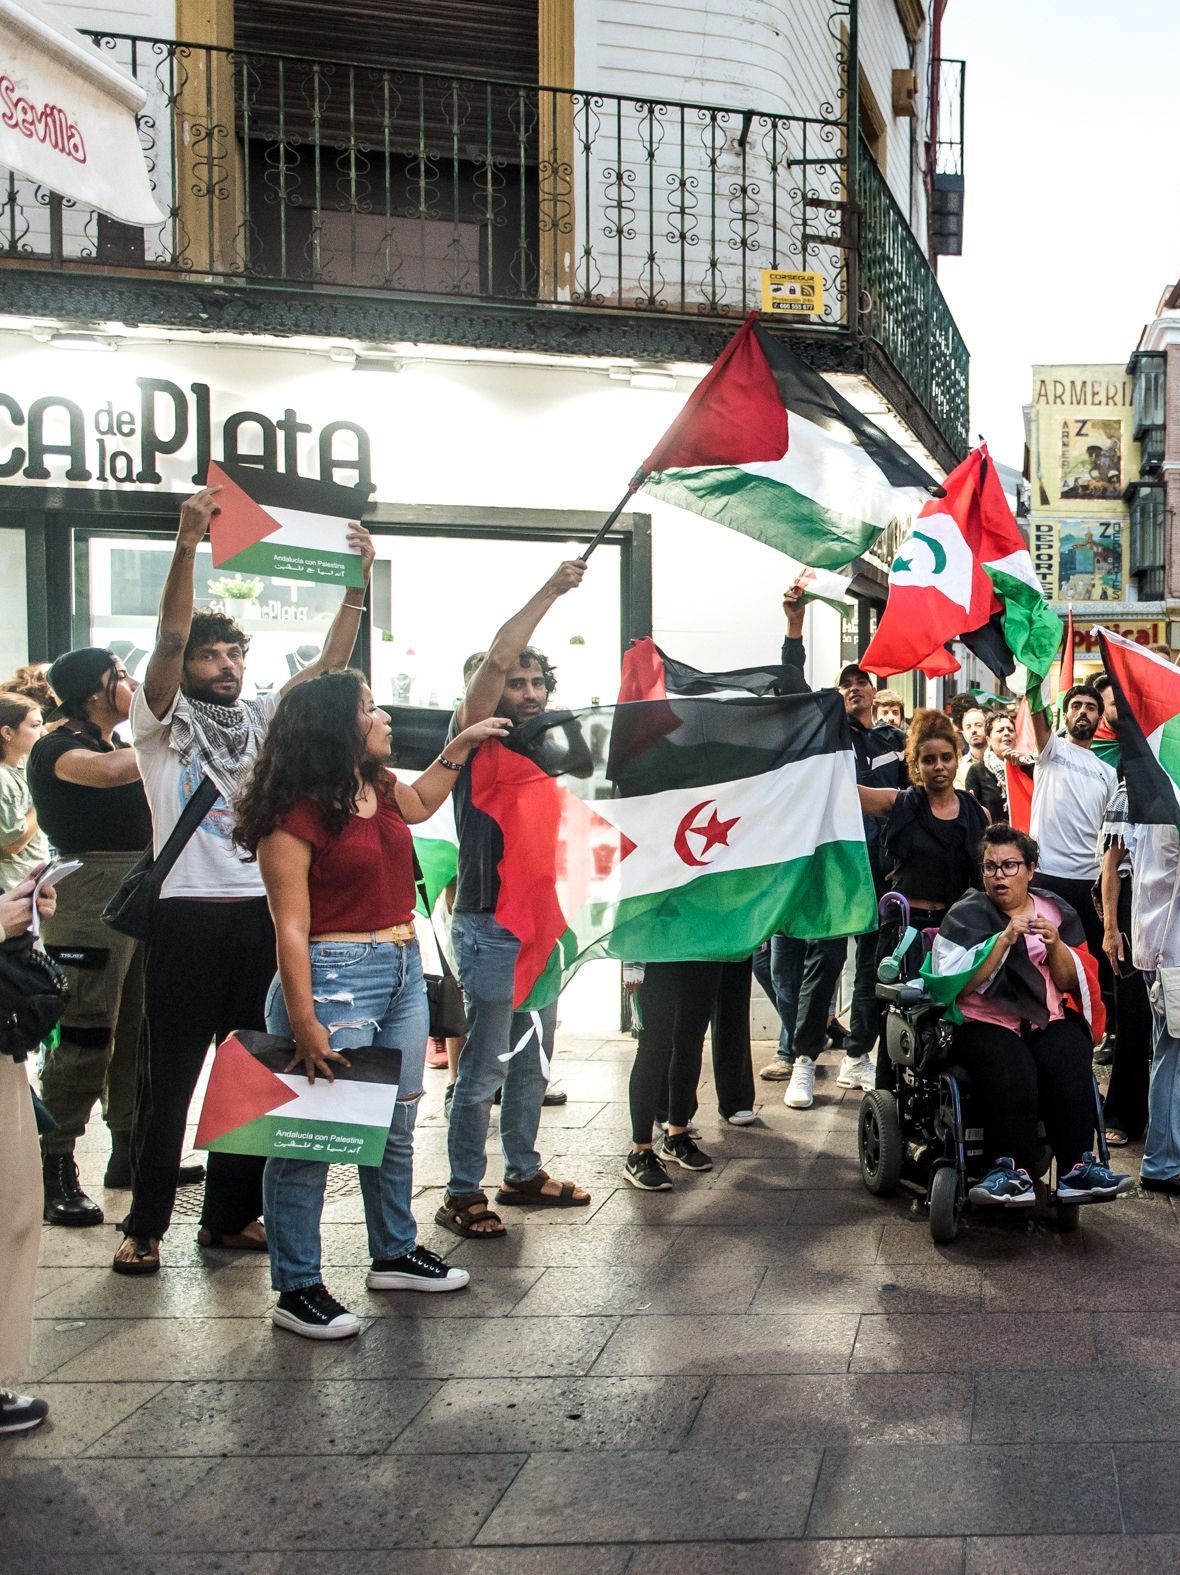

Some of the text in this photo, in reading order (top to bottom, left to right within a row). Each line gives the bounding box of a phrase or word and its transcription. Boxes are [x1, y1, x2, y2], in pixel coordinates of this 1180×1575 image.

[0, 76, 87, 164] Sevilla
[1036, 379, 1134, 407] ARMERI
[94, 401, 136, 437] de
[96, 438, 136, 483] la
[317, 560, 345, 570] Palestina
[275, 1129, 313, 1140] Andalucía
[330, 1134, 364, 1145] Palestina
